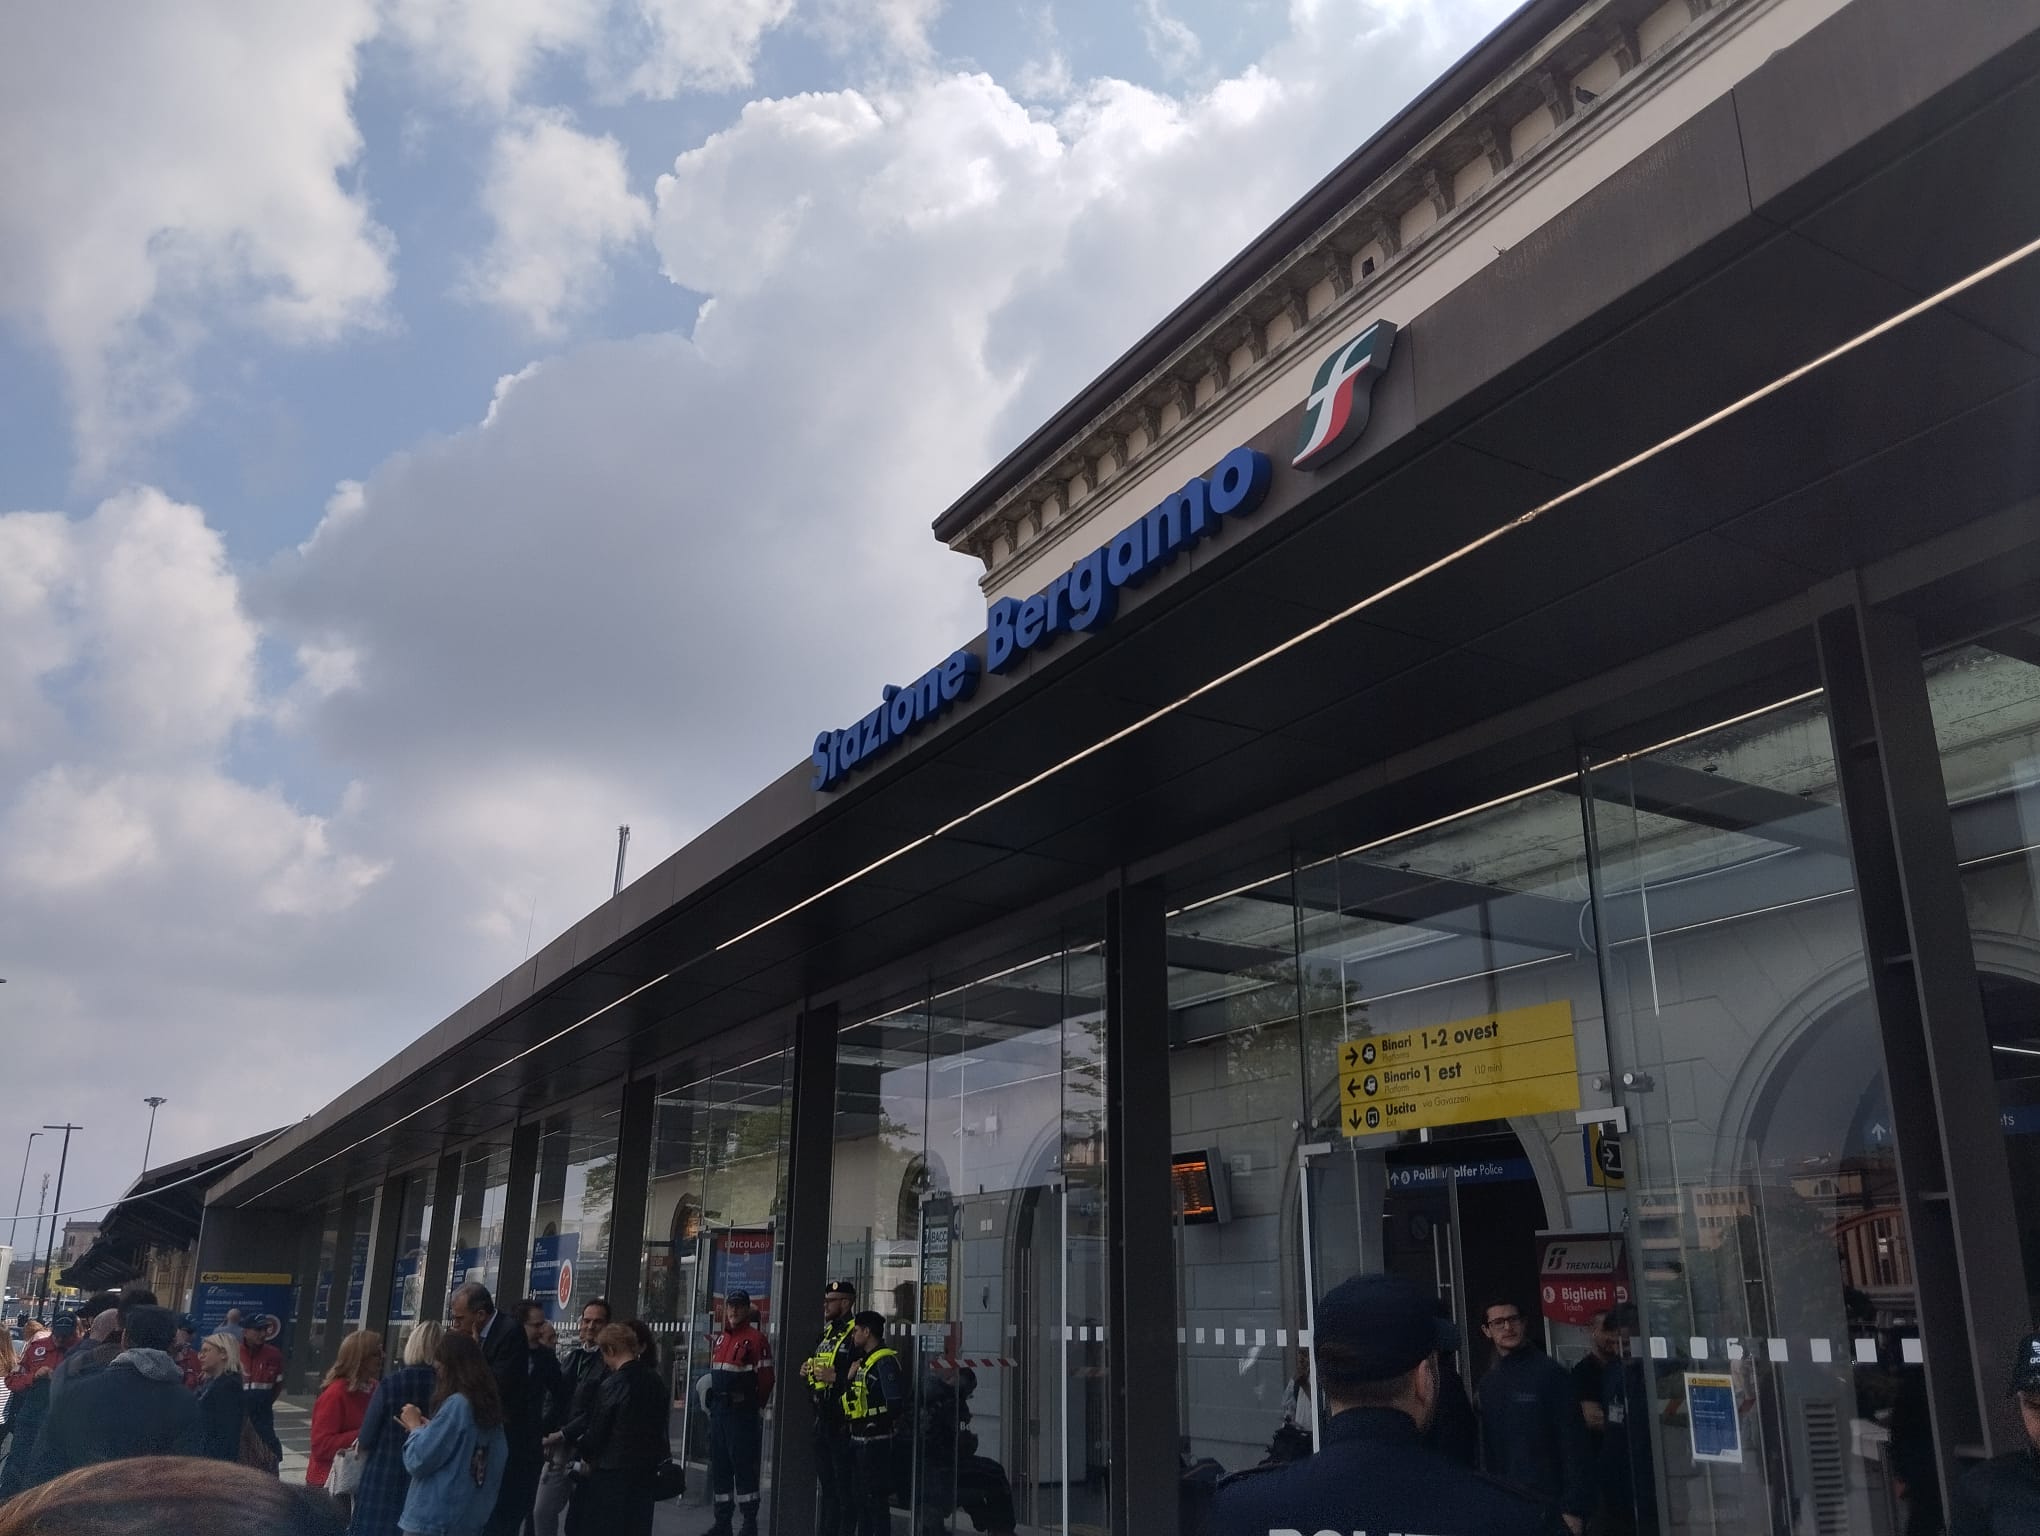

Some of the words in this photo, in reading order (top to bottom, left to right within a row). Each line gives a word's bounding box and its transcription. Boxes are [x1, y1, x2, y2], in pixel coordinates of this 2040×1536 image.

[811, 649, 980, 792] Stazione
[986, 446, 1273, 674] Bergamo
[1382, 1035, 1412, 1052] Binari
[1421, 1028, 1448, 1050] 1-2
[1454, 1021, 1499, 1044] ovest
[1384, 1068, 1421, 1084] Binario
[1423, 1065, 1431, 1082] 1
[1438, 1062, 1463, 1080] est
[1386, 1101, 1417, 1116] Uscita
[1479, 1163, 1503, 1176] Police
[1566, 1262, 1612, 1270] TRENITALIA
[1561, 1287, 1607, 1303] Biglietti
[1563, 1303, 1584, 1312] Tickets
